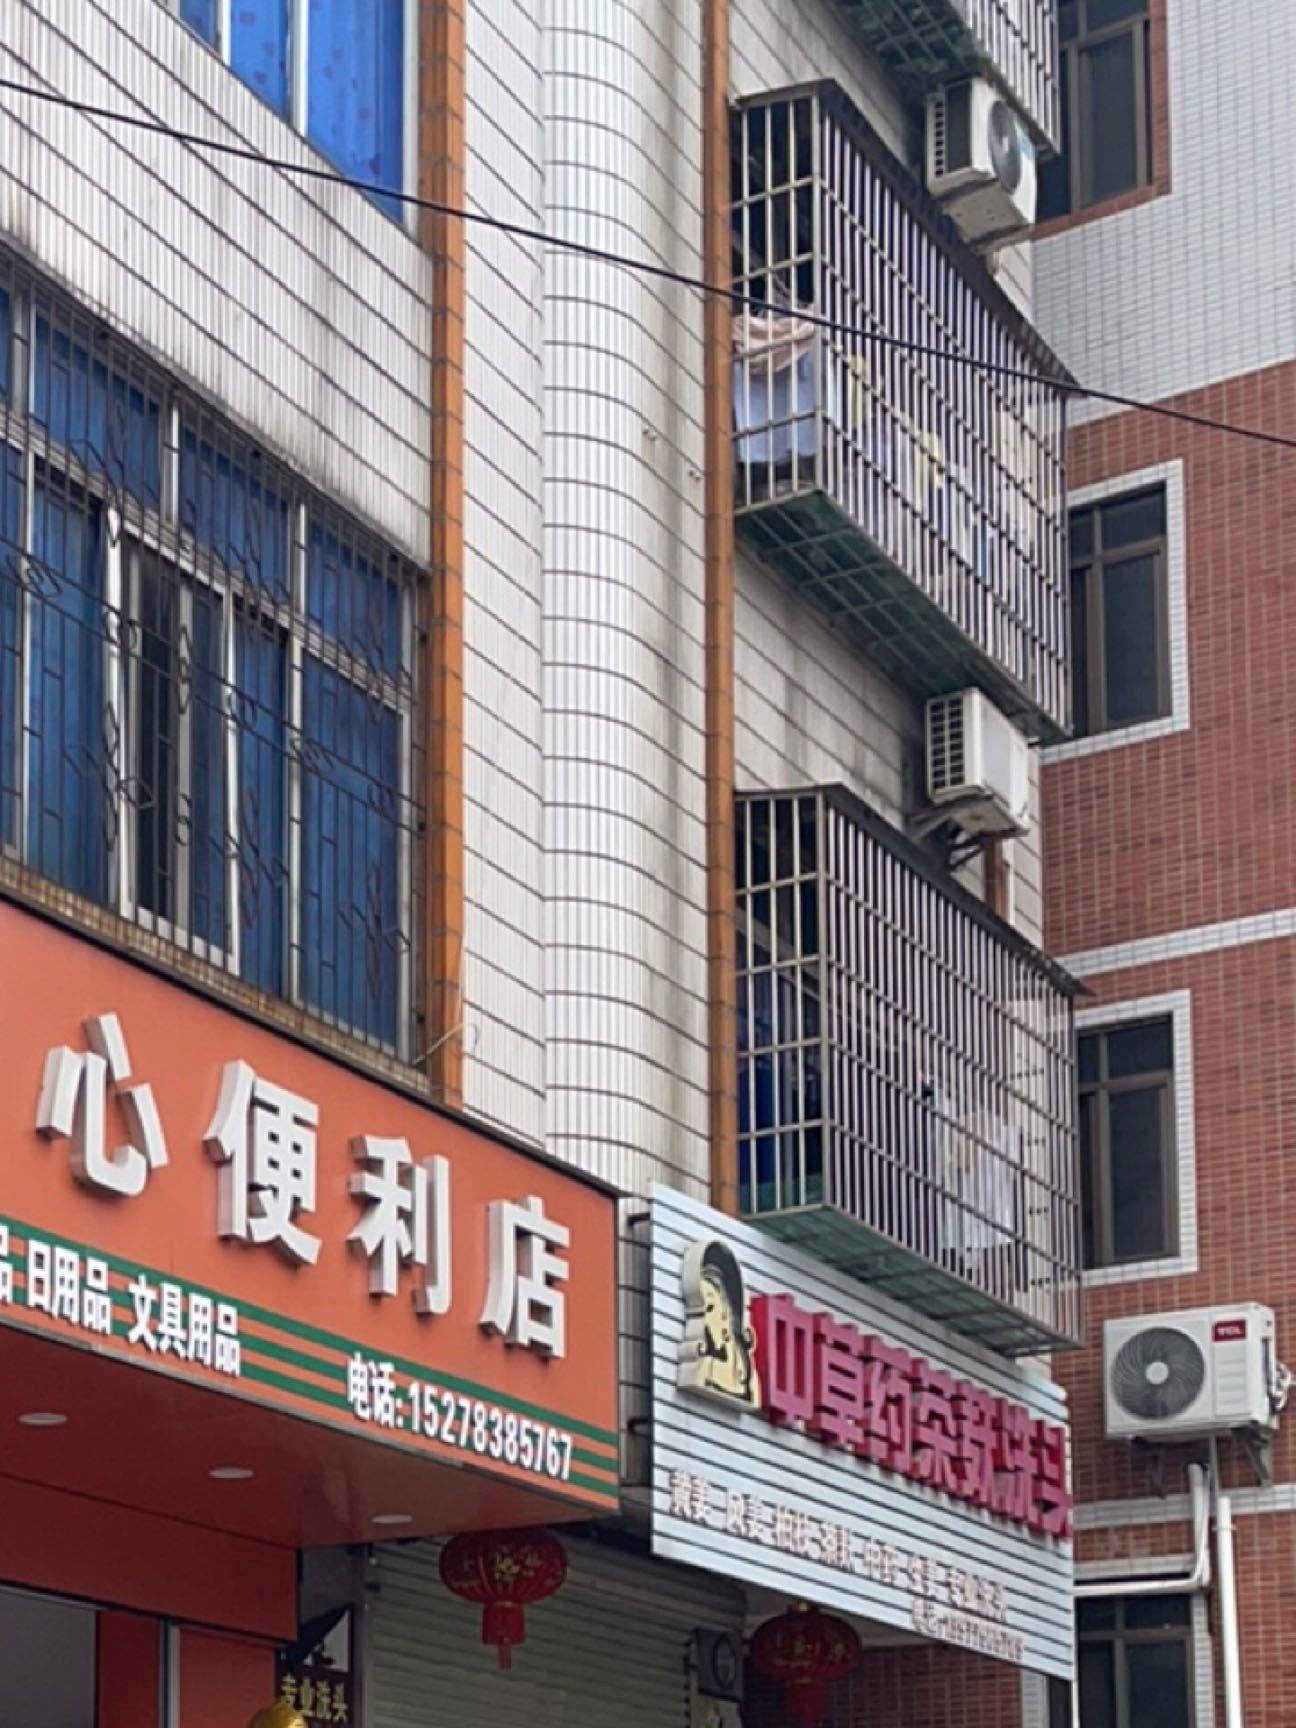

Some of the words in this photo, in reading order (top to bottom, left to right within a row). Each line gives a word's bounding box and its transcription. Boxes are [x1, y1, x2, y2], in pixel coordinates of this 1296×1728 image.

[26, 1239, 111, 1337] 日用品
[128, 1275, 241, 1378] 文具用品
[1217, 1326, 1241, 1336] TCL
